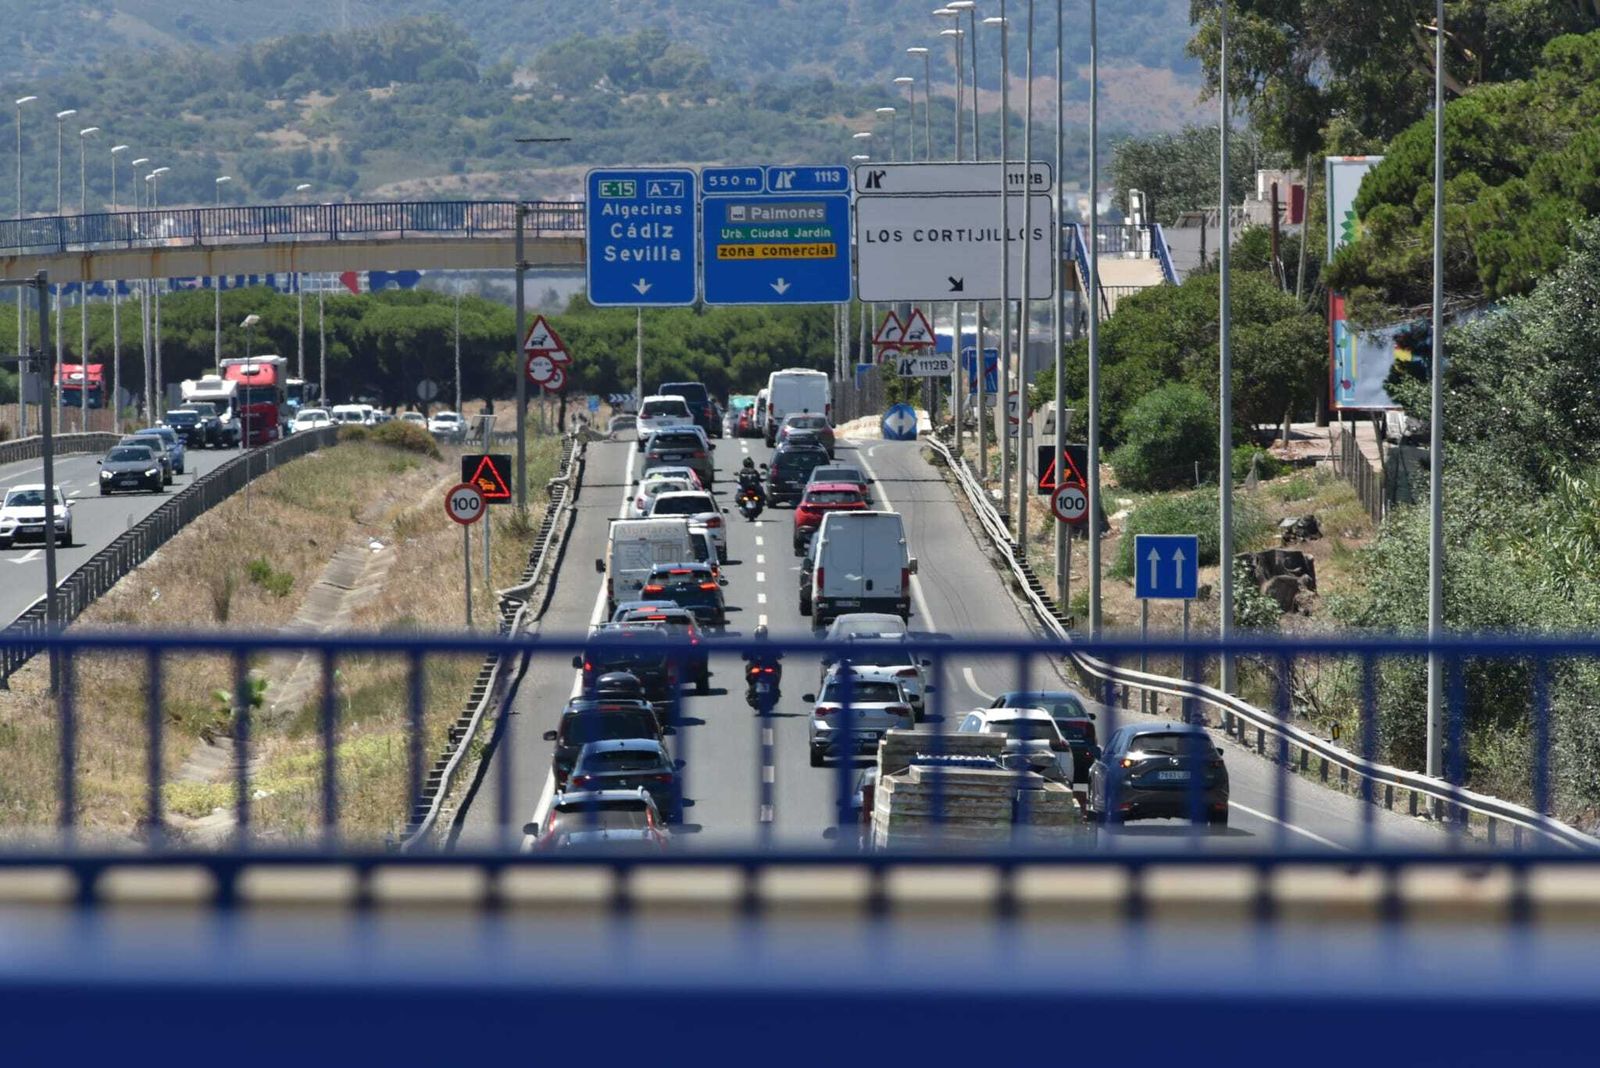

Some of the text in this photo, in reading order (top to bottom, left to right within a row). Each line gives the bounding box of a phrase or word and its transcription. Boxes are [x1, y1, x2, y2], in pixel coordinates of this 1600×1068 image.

[709, 176, 757, 187] 550 m
[814, 171, 841, 183] 1113
[601, 182, 634, 196] E-15
[601, 203, 682, 219] Algeciras
[751, 207, 824, 220] Palmones
[610, 222, 673, 239] Cádiz
[721, 228, 745, 239] Urb.
[750, 227, 789, 239] Ciudad
[866, 229, 902, 243] LOS
[604, 245, 681, 262] Sevilla
[719, 243, 834, 257] zona comercial
[919, 360, 949, 371] 1112B
[452, 497, 480, 511] 100
[1058, 496, 1086, 511] 100
